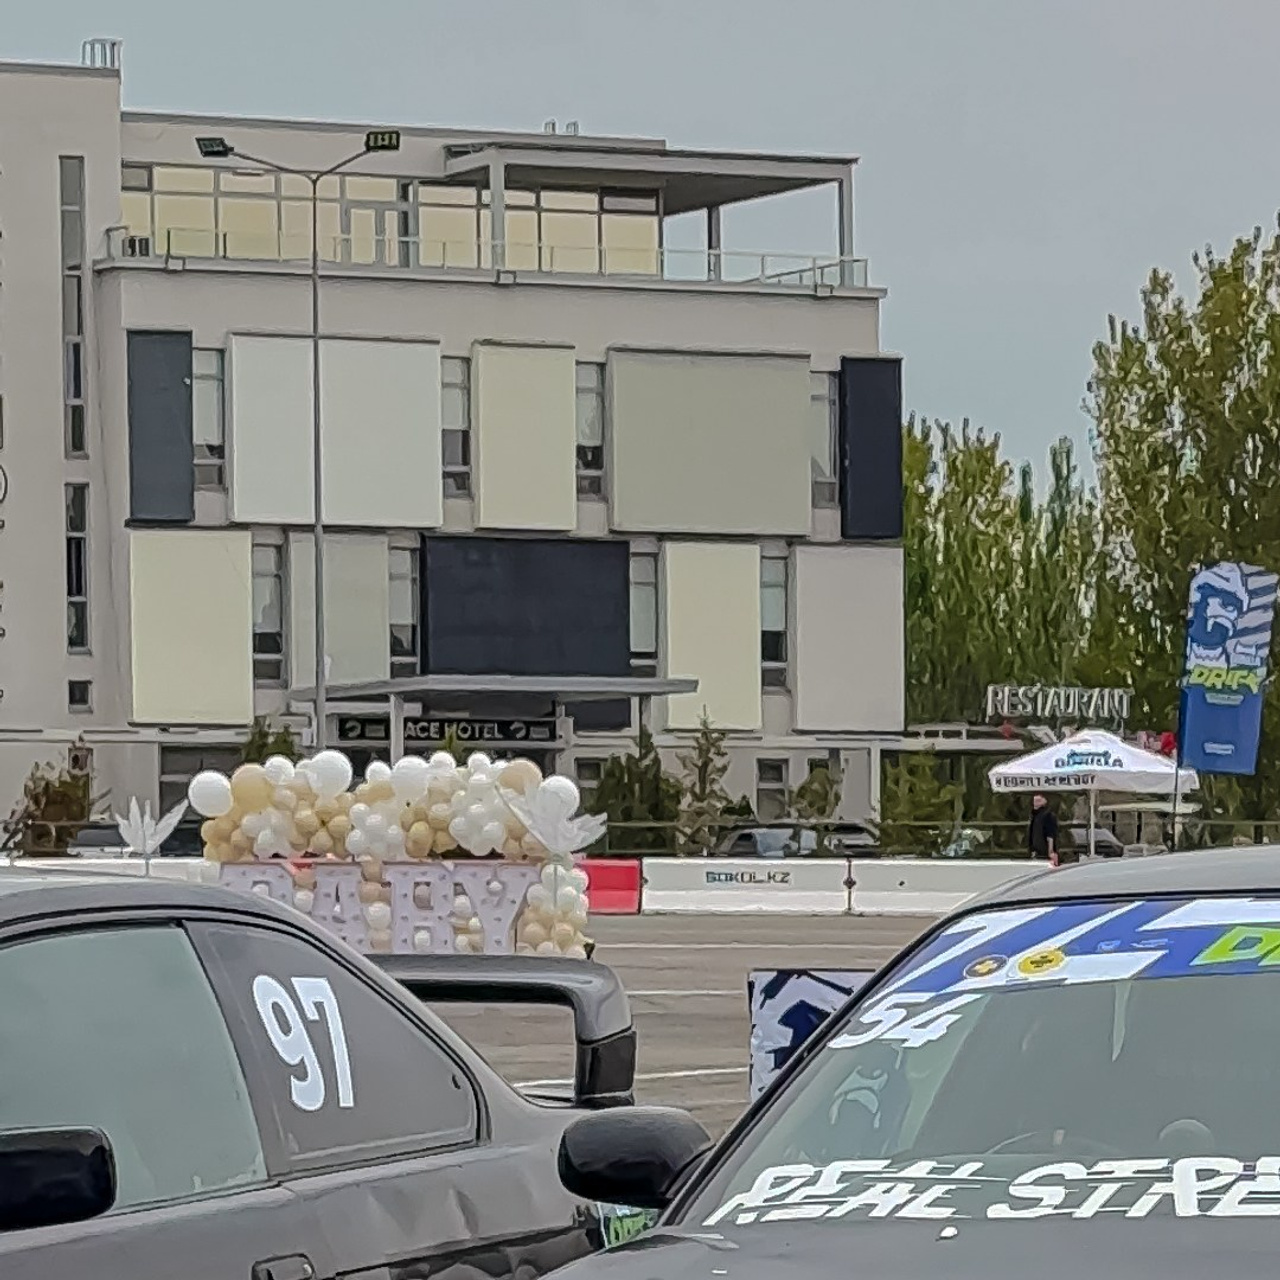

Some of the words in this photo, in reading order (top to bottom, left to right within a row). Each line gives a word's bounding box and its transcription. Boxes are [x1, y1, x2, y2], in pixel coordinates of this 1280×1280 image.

[985, 684, 1135, 719] RESTAURANT
[403, 721, 440, 739] ACE
[444, 721, 503, 739] HOTEL
[252, 974, 354, 1112] 97
[827, 992, 985, 1048] 54
[702, 1158, 988, 1226] REAL
